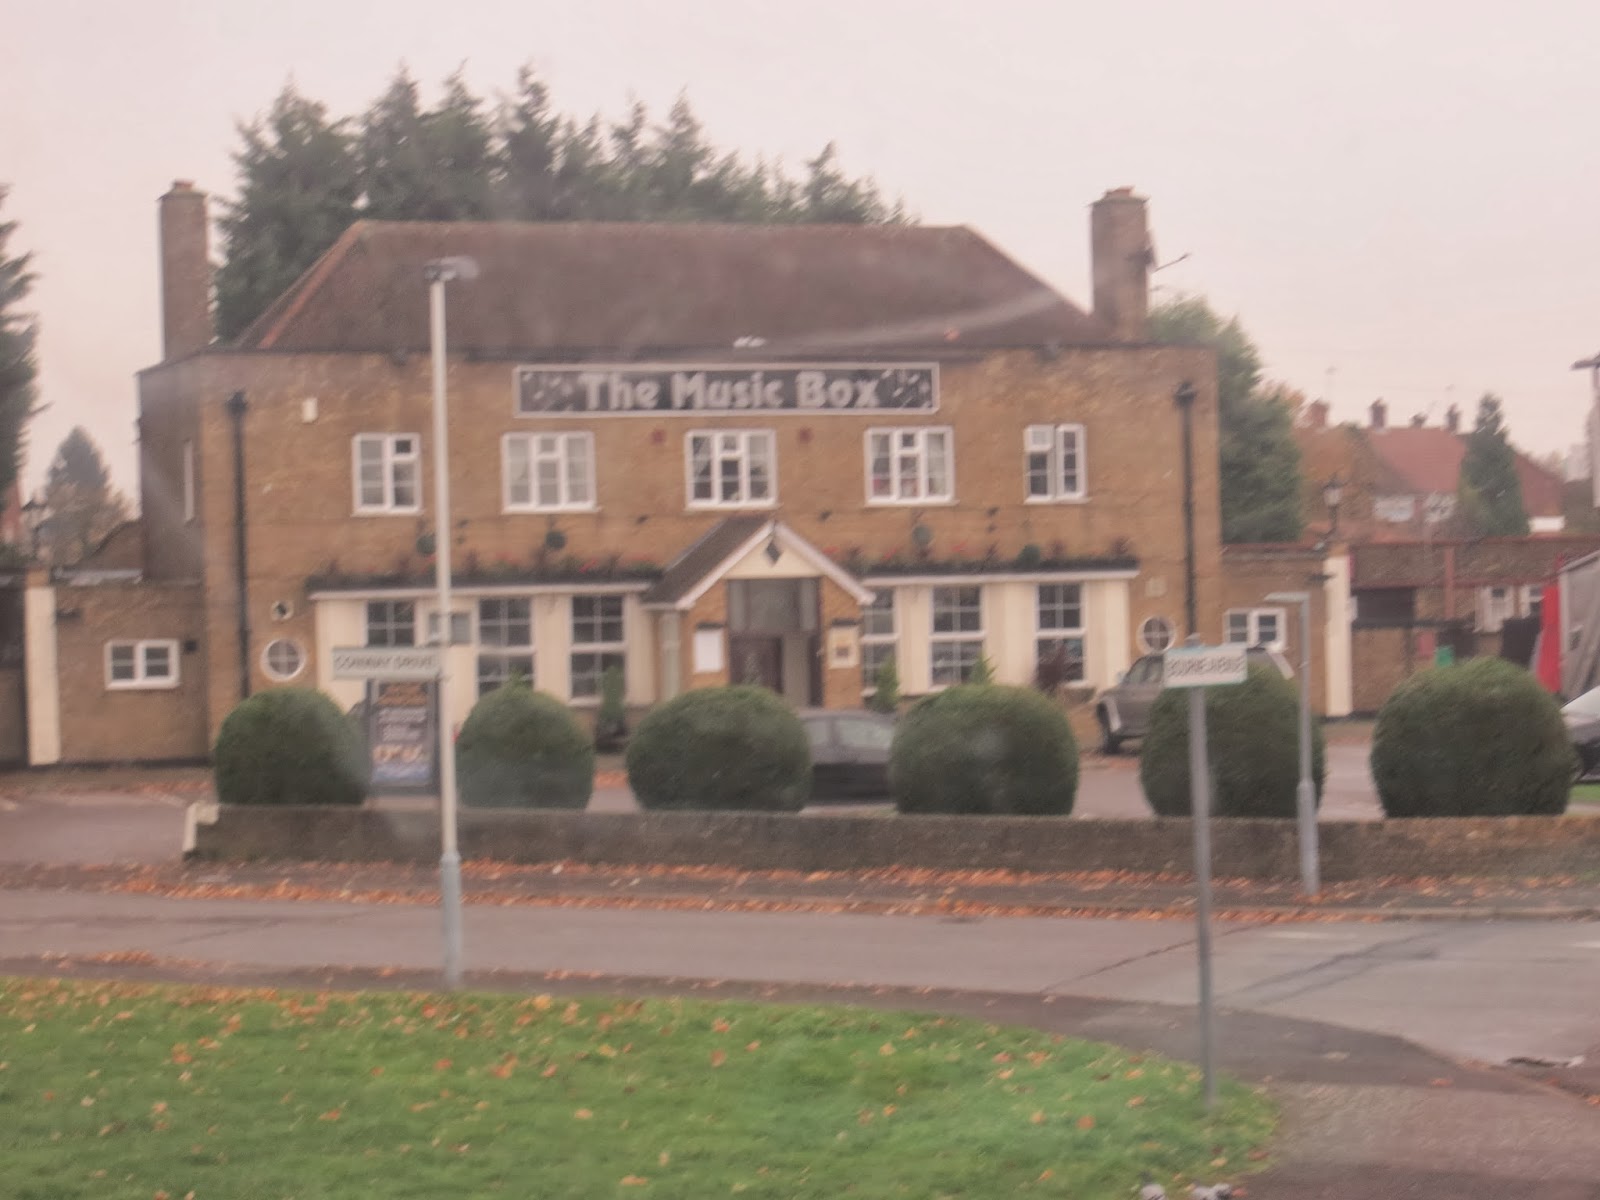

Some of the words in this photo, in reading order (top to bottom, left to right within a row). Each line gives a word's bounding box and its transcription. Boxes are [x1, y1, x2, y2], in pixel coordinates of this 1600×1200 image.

[578, 371, 660, 411] The
[671, 371, 786, 410] Music
[796, 370, 882, 409] Box
[395, 654, 434, 669] DRIVE
